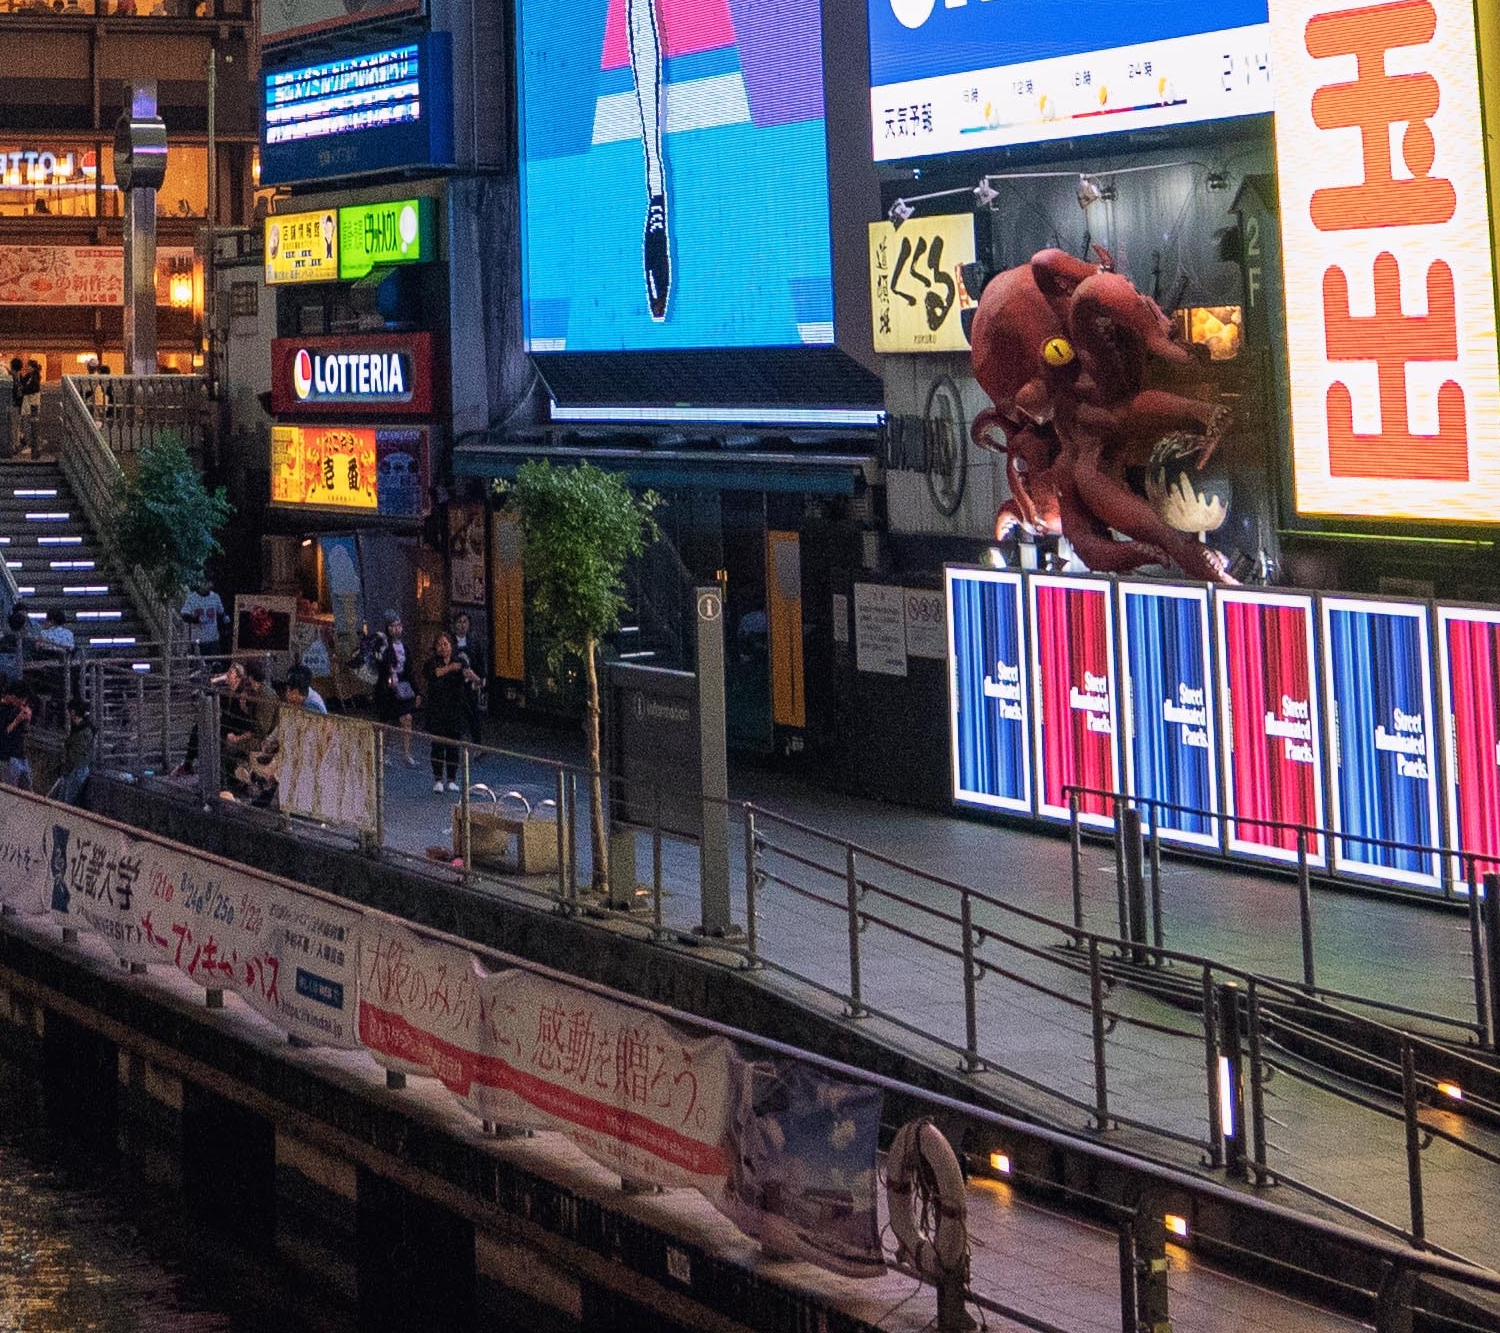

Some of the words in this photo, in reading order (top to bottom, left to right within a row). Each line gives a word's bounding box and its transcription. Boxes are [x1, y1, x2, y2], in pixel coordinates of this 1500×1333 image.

[890, 235, 956, 332] くくる
[1246, 215, 1265, 309] 2F
[314, 351, 404, 395] LOTTERIA
[70, 836, 143, 910] 近畿大学
[368, 933, 708, 1127] 大阪のみらに、感動を贈ろう。
